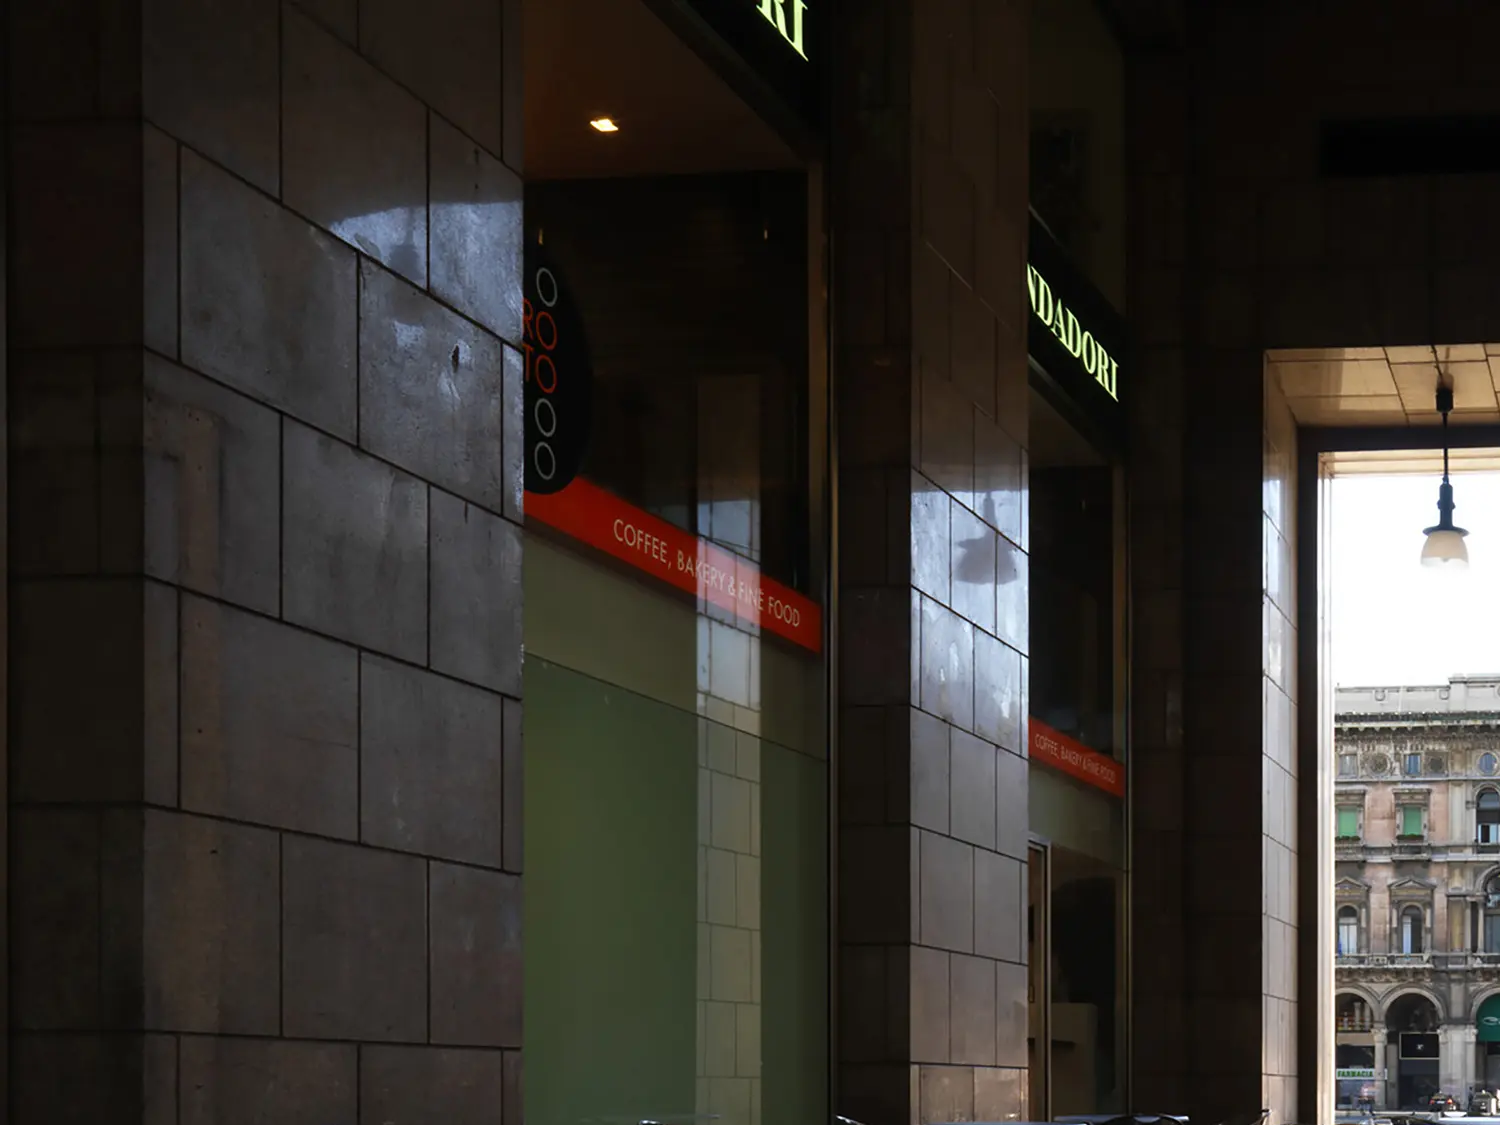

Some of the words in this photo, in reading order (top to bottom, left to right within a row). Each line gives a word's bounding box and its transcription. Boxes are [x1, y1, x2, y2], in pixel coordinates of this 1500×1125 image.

[613, 519, 671, 570] COFFEE,
[677, 550, 725, 591] BAKERY
[728, 574, 736, 596] &
[738, 581, 764, 610] FINE
[768, 596, 800, 627] FOOD
[1337, 1070, 1374, 1078] FARMACIA
